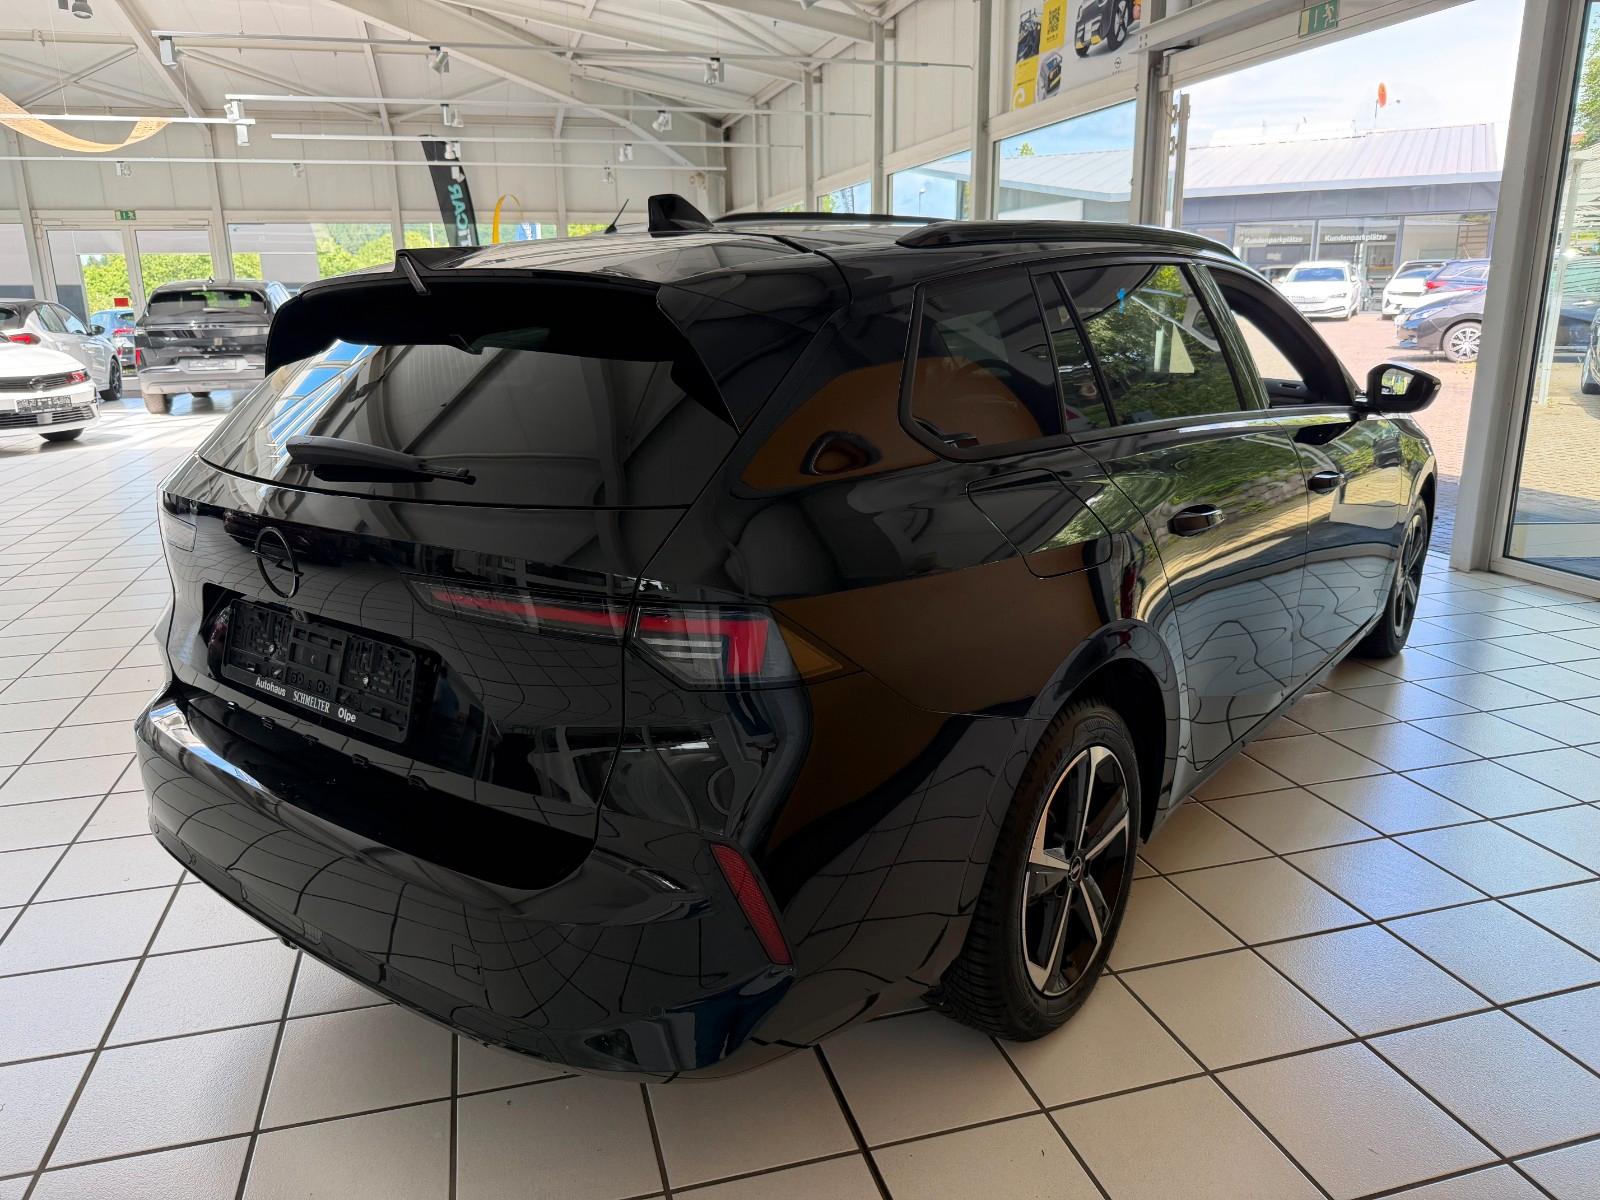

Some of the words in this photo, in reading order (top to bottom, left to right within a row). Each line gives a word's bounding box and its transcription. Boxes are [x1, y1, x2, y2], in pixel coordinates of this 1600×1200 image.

[1324, 233, 1388, 242] Kundenparkplätze
[256, 677, 286, 697] Autohaus
[293, 691, 330, 713] SCHMELTER
[338, 707, 356, 722] Olpe
